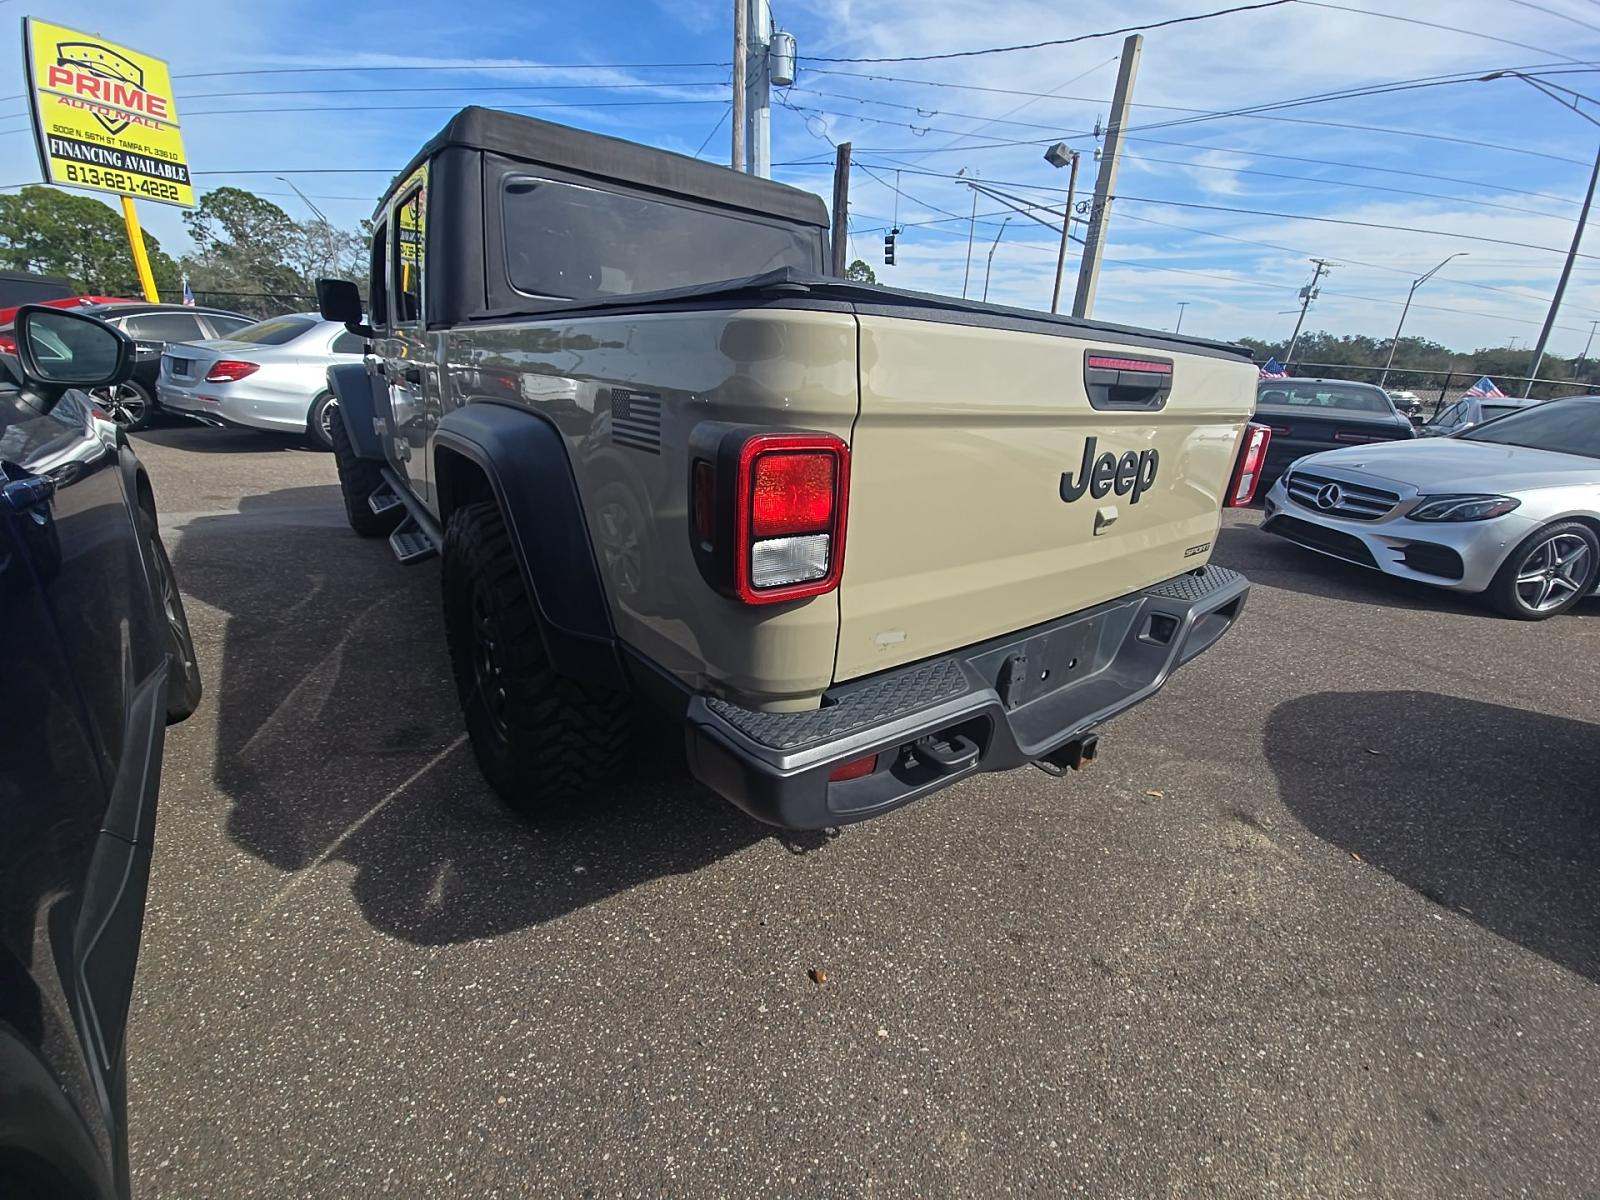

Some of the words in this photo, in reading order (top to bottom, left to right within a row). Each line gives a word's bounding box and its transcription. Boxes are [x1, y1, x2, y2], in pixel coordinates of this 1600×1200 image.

[48, 65, 167, 118] PRIME
[58, 95, 110, 116] AUTO
[115, 109, 165, 132] MALL
[51, 138, 122, 168] FINANCING
[124, 154, 187, 182] AVAILABLE
[52, 124, 75, 135] 5002
[106, 136, 115, 145] ST
[118, 139, 143, 153] TAMPA
[154, 148, 178, 161] 33610
[66, 164, 179, 201] 813-621-4222
[1060, 436, 1160, 505] Jeep
